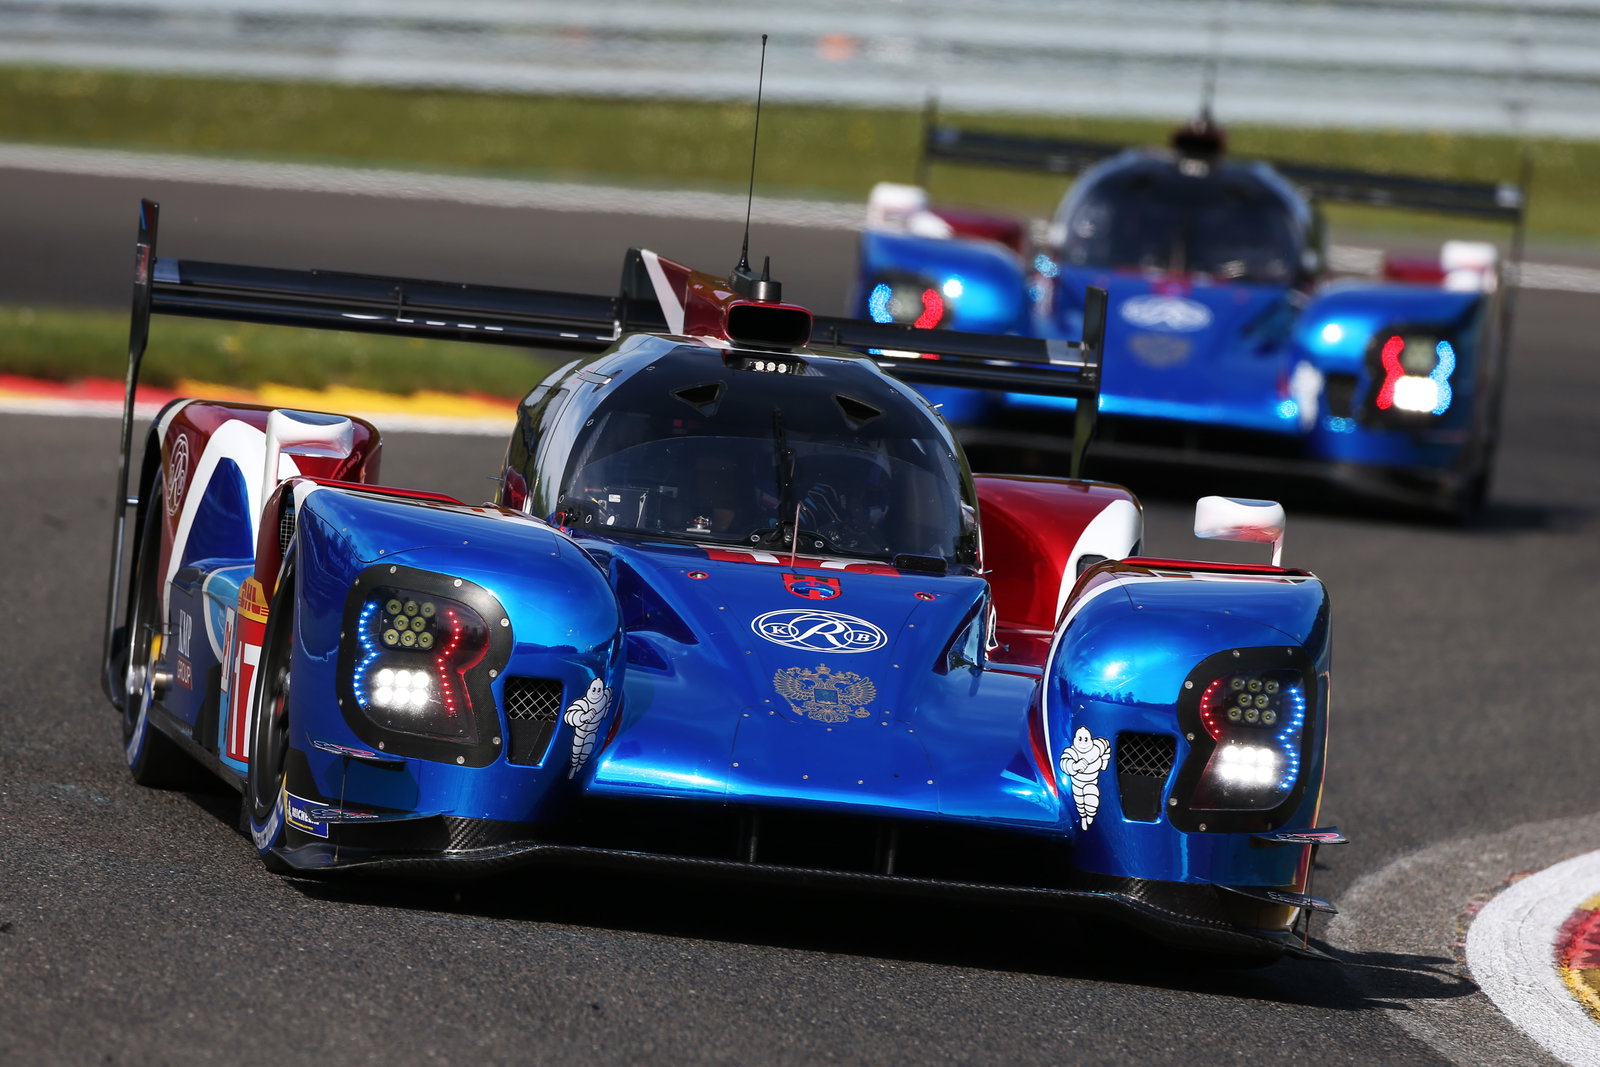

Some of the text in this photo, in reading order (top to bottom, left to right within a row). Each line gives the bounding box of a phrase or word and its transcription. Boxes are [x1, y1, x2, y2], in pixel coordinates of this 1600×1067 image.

[239, 580, 261, 615] DHL
[771, 625, 788, 635] K
[856, 633, 870, 642] B
[231, 641, 262, 757] 17
